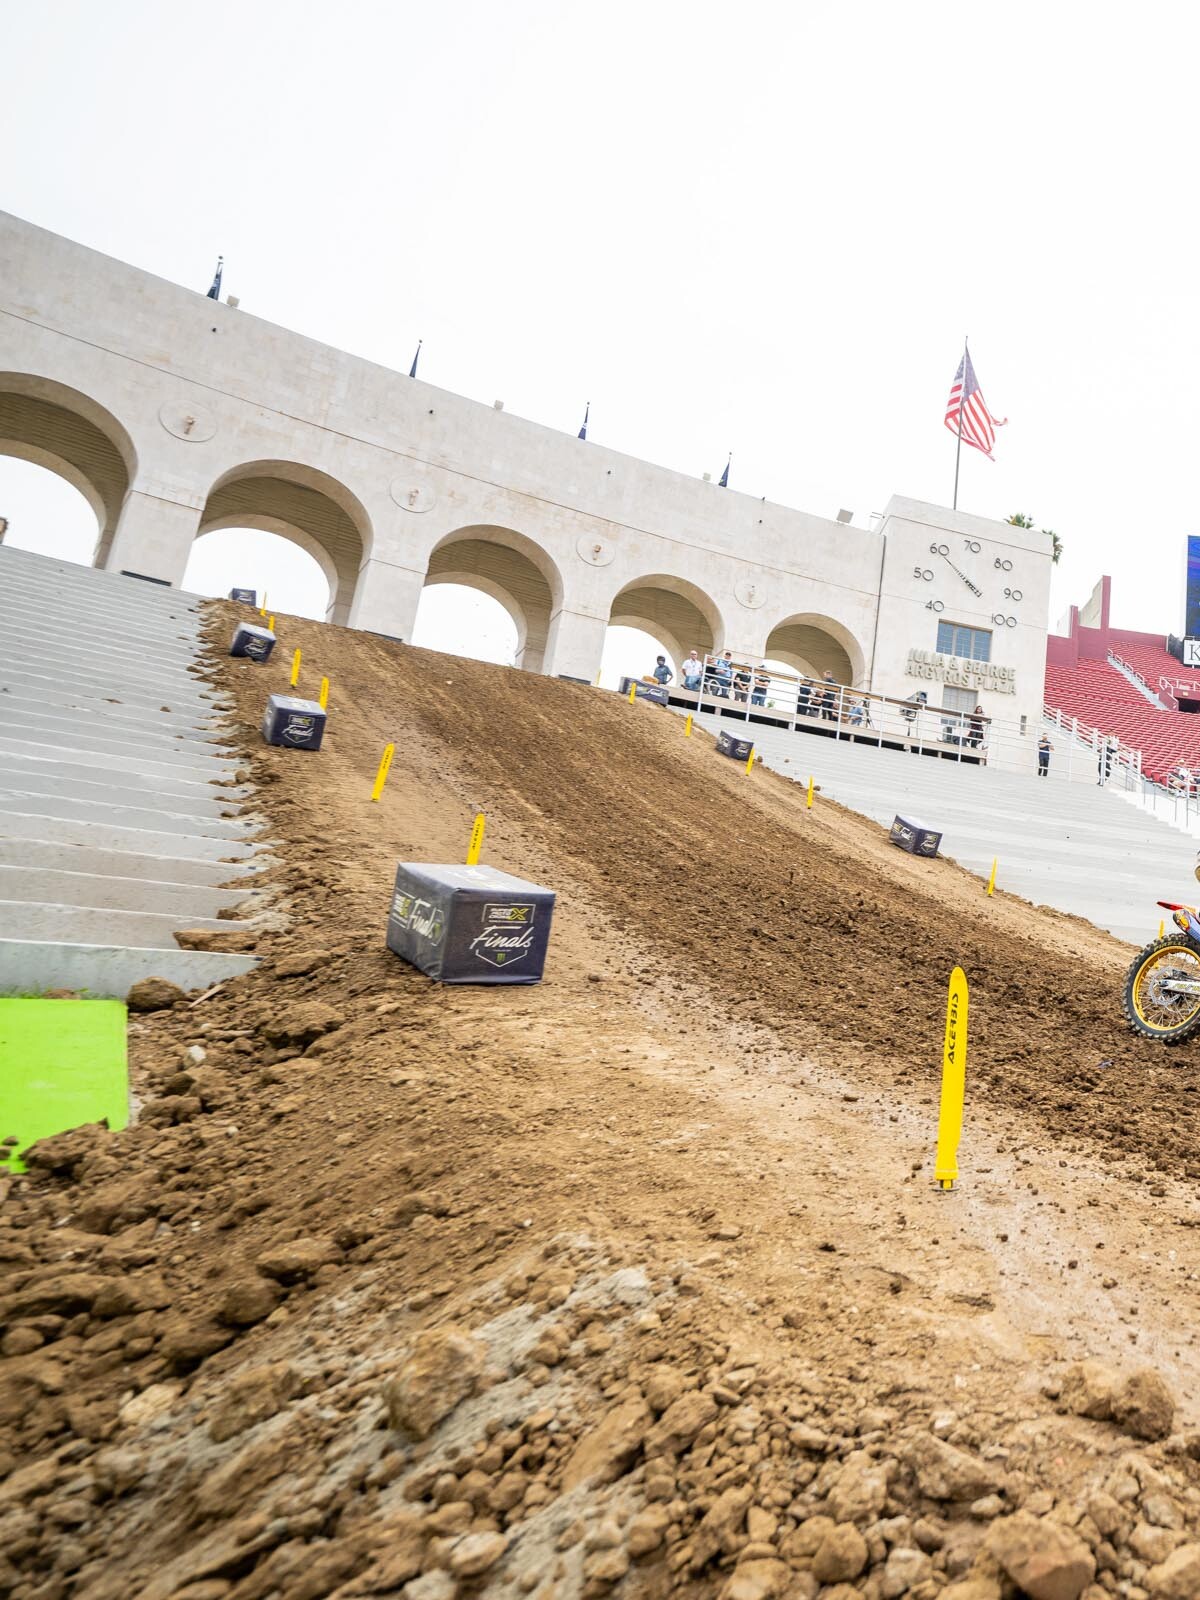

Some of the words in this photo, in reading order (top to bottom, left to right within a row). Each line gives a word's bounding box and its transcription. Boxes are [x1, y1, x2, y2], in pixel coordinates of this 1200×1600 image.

[929, 542, 950, 557] 60
[963, 540, 982, 553] 70
[993, 557, 1013, 572] 80
[913, 567, 934, 582] 50
[1003, 588, 1023, 602] 90
[925, 600, 945, 613] 40
[991, 613, 1017, 628] 100
[907, 648, 945, 668] JULIA
[948, 657, 958, 671] &
[963, 660, 1017, 681] GEORGE
[904, 663, 970, 687] ARGYROS
[973, 675, 1017, 696] PLAZA
[469, 925, 535, 949] Finals
[947, 992, 959, 1065] ACERBIS
